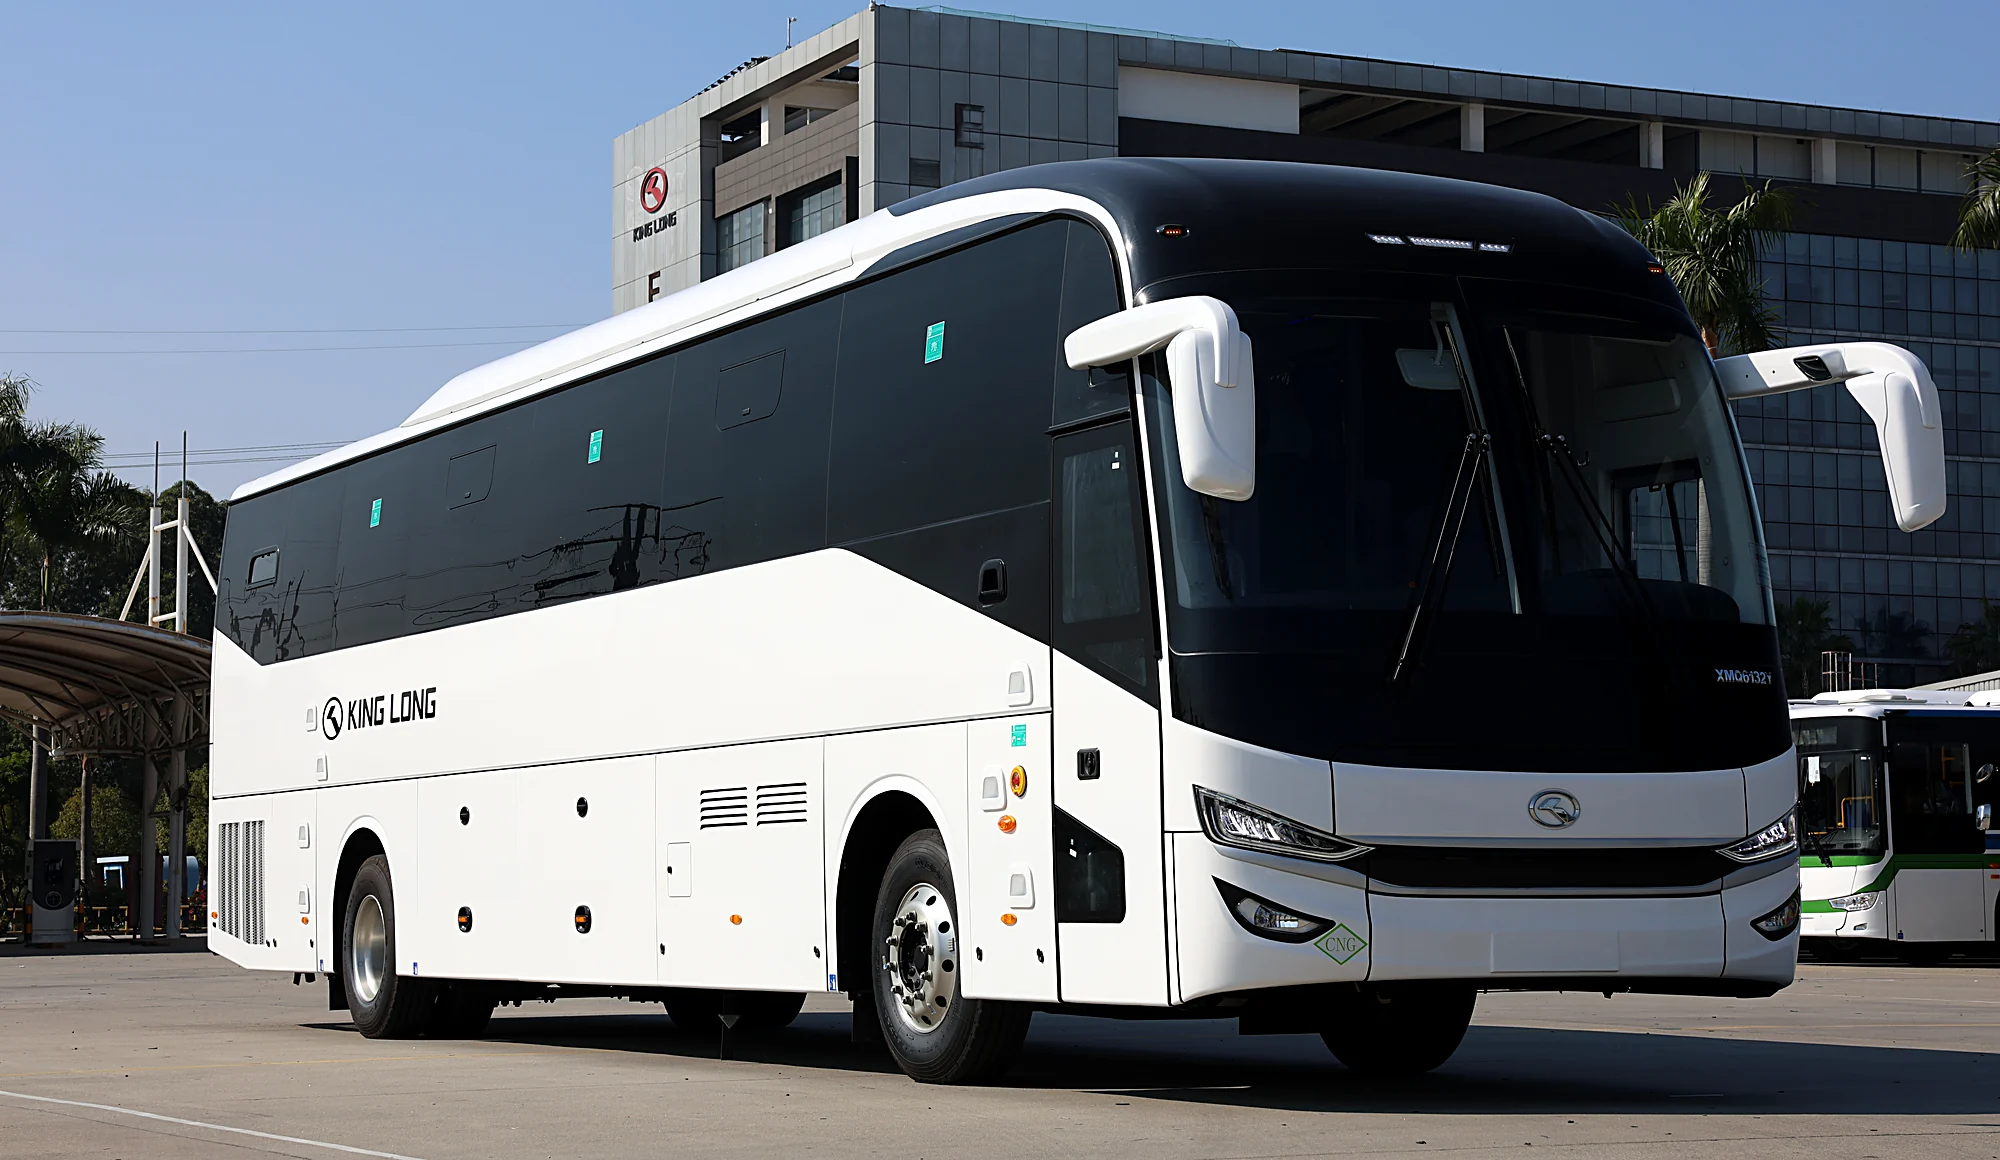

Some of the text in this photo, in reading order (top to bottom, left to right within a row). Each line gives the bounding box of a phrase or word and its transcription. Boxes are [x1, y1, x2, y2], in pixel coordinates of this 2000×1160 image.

[633, 211, 677, 242] KING LONG
[348, 687, 437, 730] KING LONG
[1325, 937, 1357, 952] CNG
